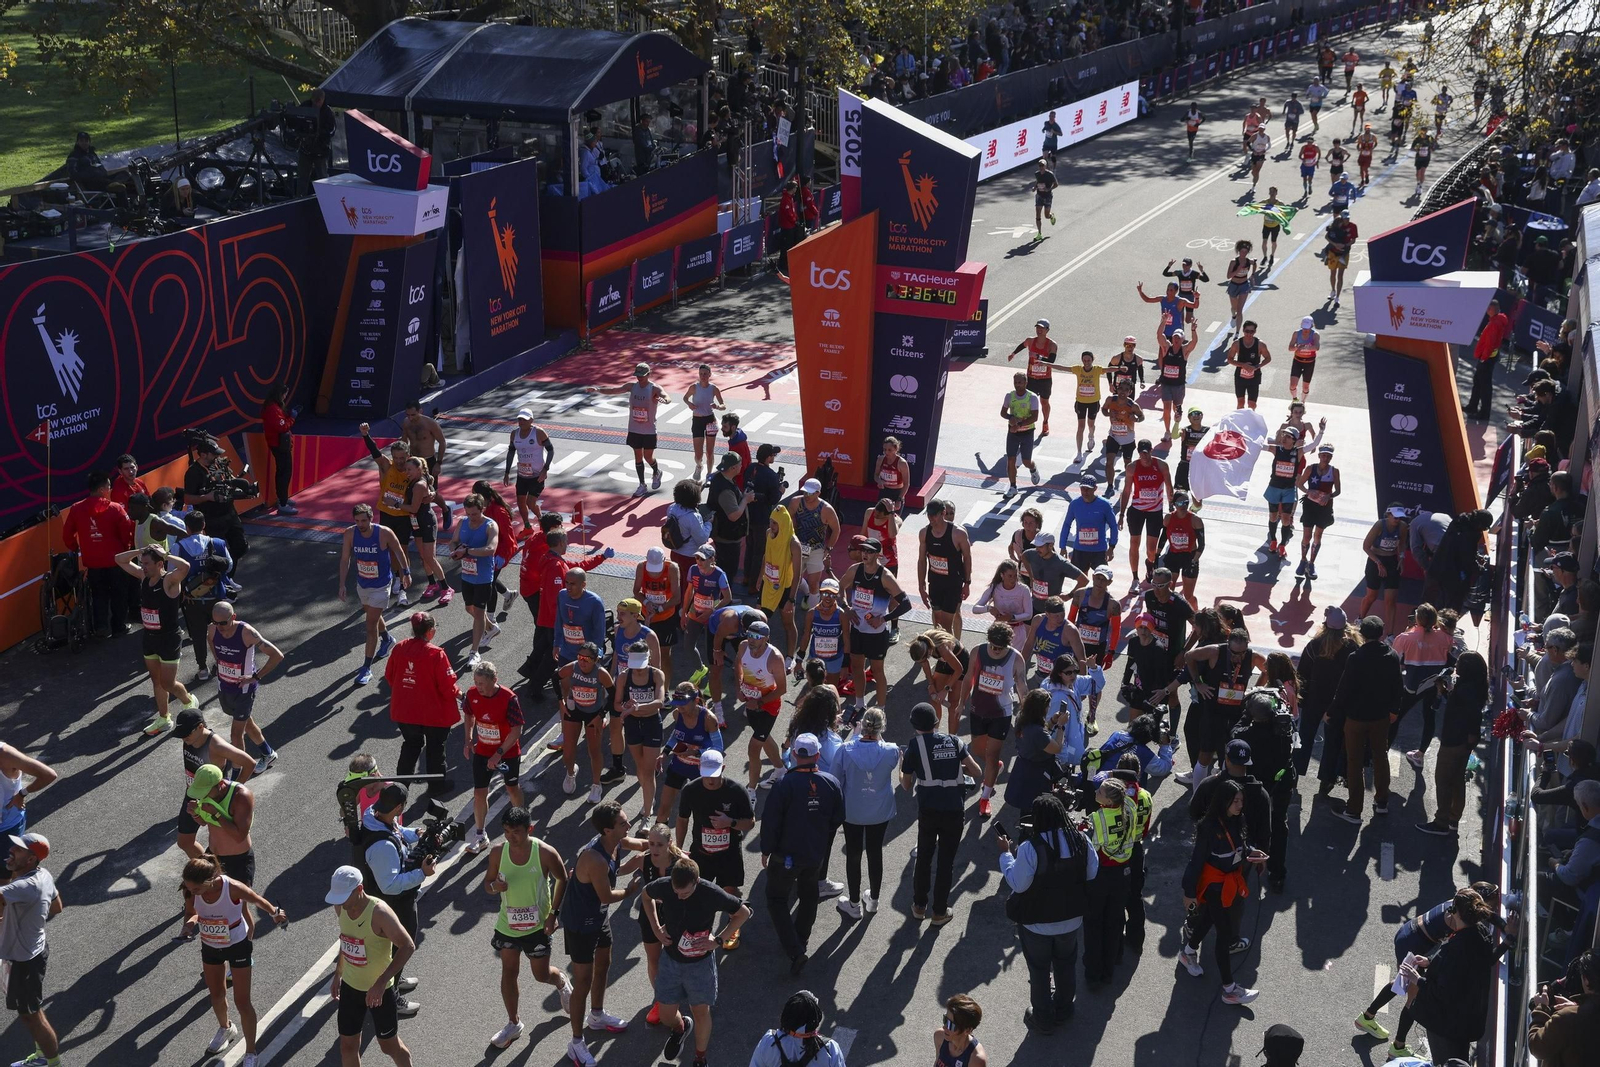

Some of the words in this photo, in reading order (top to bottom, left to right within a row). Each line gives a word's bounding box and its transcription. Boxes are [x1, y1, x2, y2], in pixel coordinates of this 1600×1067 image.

[940, 110, 950, 121] YOU
[845, 109, 861, 168] 2025
[367, 150, 402, 173] tcs
[889, 221, 907, 233] tcs
[908, 237, 928, 246] YORK
[930, 239, 947, 247] CITY
[889, 243, 932, 254] MARATHON
[1401, 236, 1447, 267] tcs
[690, 254, 705, 262] UNITED
[687, 259, 706, 269] AIRLINES
[810, 261, 851, 291] tcs
[642, 276, 652, 289] tcs
[409, 285, 425, 305] tcs
[489, 298, 501, 314] tcs
[1412, 307, 1426, 316] tcs
[491, 315, 501, 326] NEW
[502, 310, 515, 322] YORK
[515, 304, 527, 317] CITY
[491, 319, 519, 336] MARATHON
[405, 334, 419, 346] TATA
[891, 348, 924, 358] Citizens
[1384, 392, 1412, 402] Citizens
[37, 404, 57, 419] tcs
[61, 414, 82, 426] YORK
[83, 407, 101, 420] CITY
[49, 422, 88, 440] ARATHON
[824, 427, 844, 435] ESPN
[645, 581, 666, 589] KEN
[813, 626, 839, 636] Hyland's
[222, 666, 236, 675] 1194
[573, 673, 597, 684] NICOLE
[981, 676, 1001, 685] 12277
[512, 913, 534, 921] 4385
